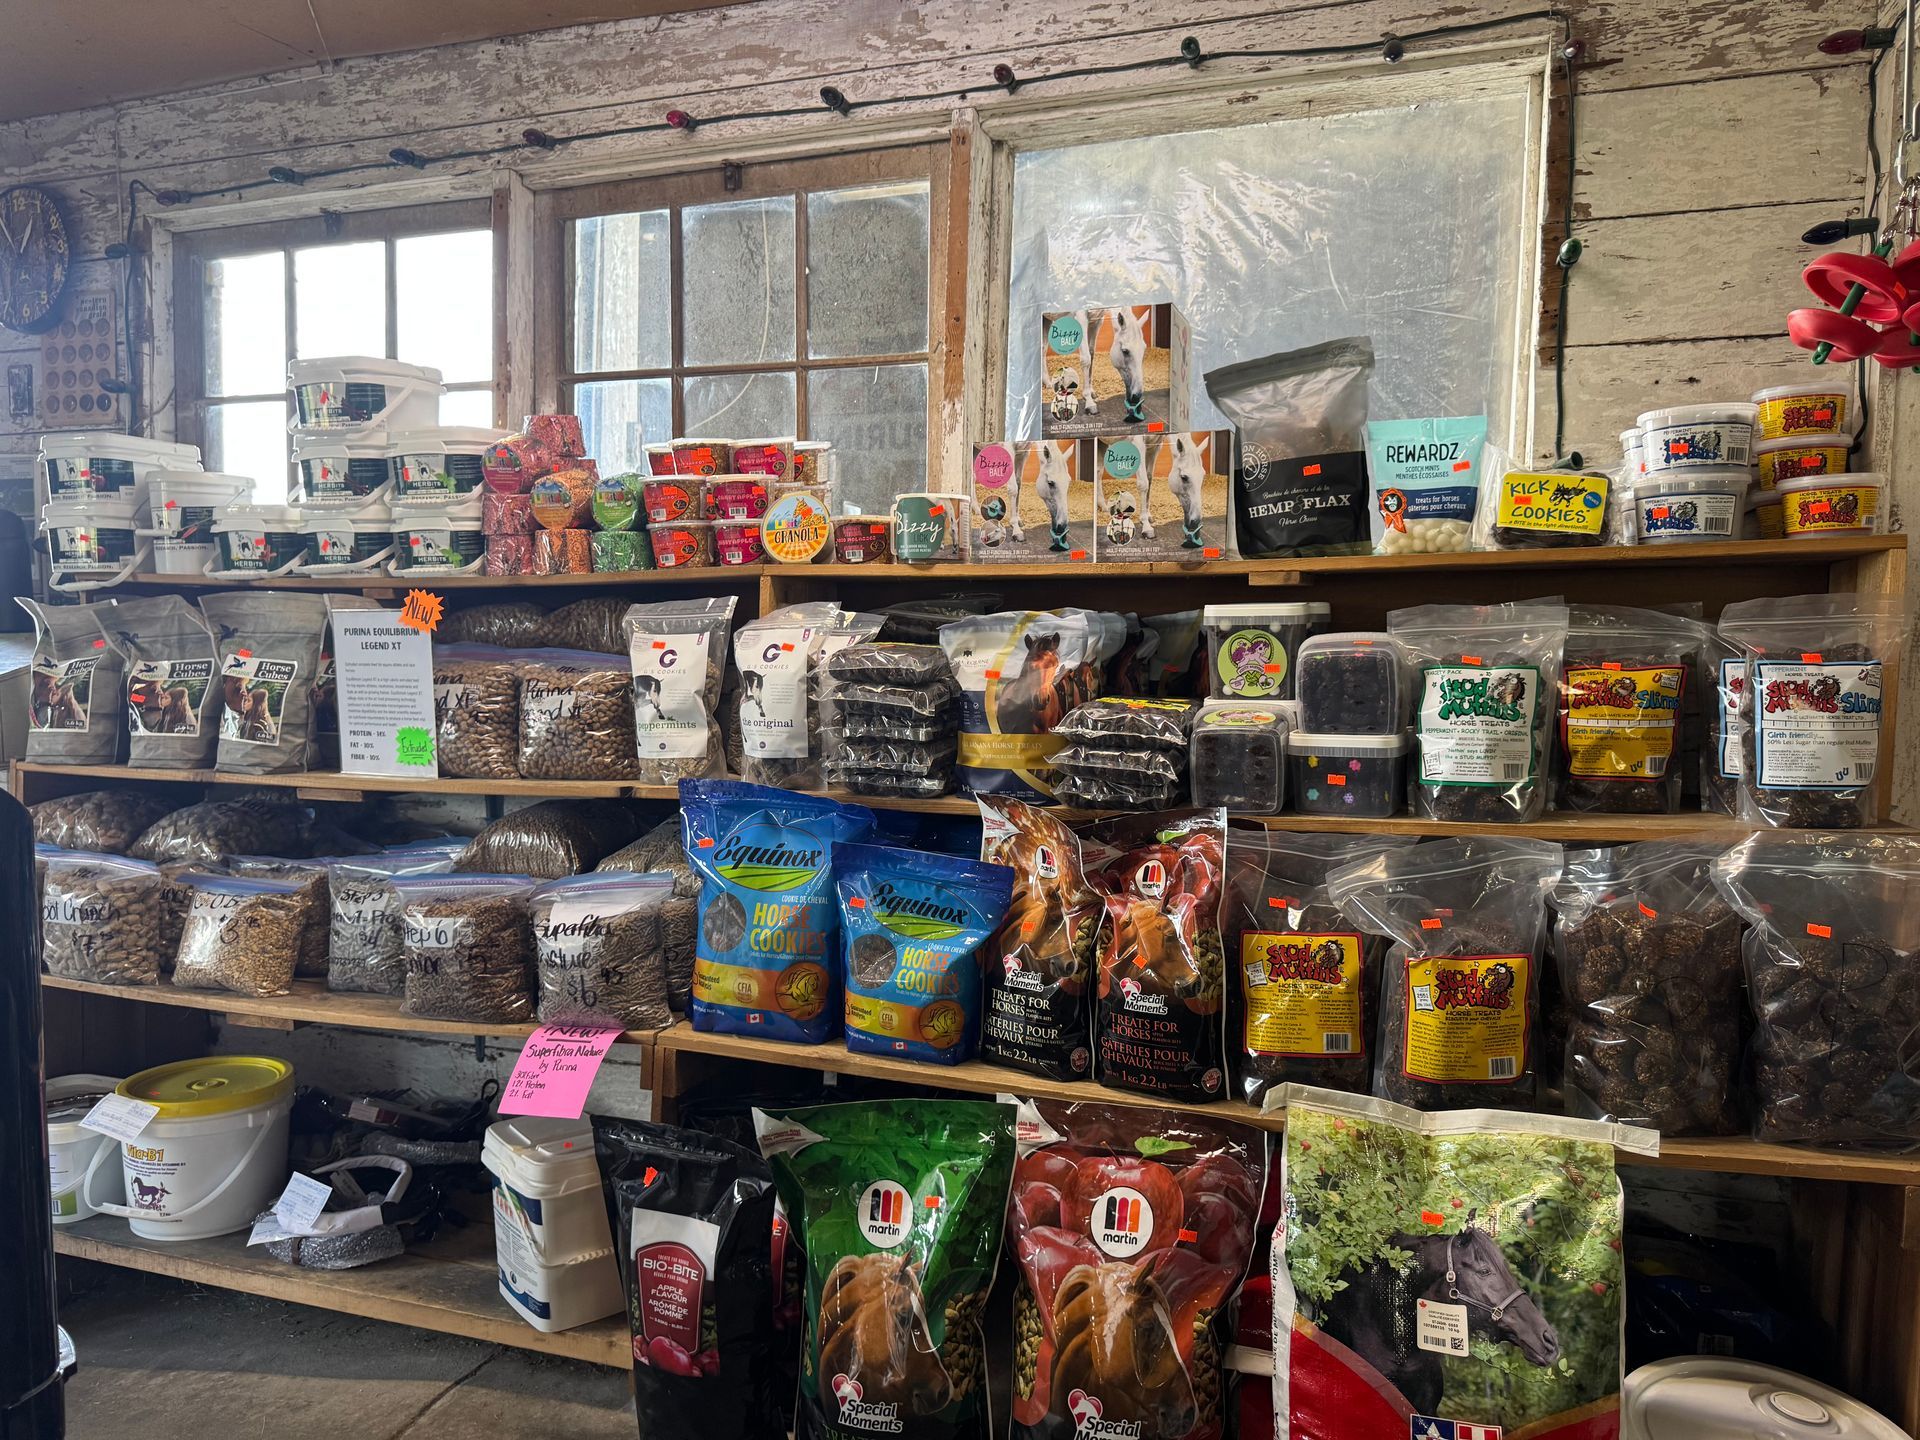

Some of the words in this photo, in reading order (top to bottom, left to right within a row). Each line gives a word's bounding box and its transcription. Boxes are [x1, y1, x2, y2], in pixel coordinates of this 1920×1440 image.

[1052, 326, 1081, 342] Bizzy
[1060, 337, 1076, 347] BALL
[1107, 449, 1139, 467] Bizzy
[1386, 443, 1460, 463] REWARDZ
[980, 455, 1011, 474] Bizzy
[989, 467, 1005, 478] BALL
[1117, 461, 1134, 471] BALL
[1248, 500, 1295, 518] HEMP
[1302, 494, 1352, 510] FLAX
[1432, 495, 1441, 503] for
[774, 526, 819, 544] GRANOLA
[895, 511, 943, 543] Bizzy
[405, 595, 434, 625] NEW
[343, 627, 371, 636] PURINA
[373, 627, 420, 636] EQUILIBRIUM
[360, 641, 390, 651] LEGEND
[391, 641, 402, 651] XT
[173, 669, 208, 679] Cubes
[175, 661, 210, 672] Horse
[260, 661, 292, 673] Horse
[257, 670, 290, 682] Cubes
[638, 720, 698, 733] peppermints
[742, 716, 752, 727] the
[753, 717, 795, 729] original
[1480, 720, 1510, 728] TREATS
[349, 730, 373, 738] PROTEIN
[1767, 731, 1787, 739] Girth
[350, 741, 360, 750] FAT
[992, 741, 1015, 750] HORSE
[350, 753, 366, 762] FIBER
[713, 836, 824, 871] Equinox
[808, 895, 830, 905] CHEVAL
[869, 884, 970, 925] Equinox
[752, 902, 812, 930] HORSE
[435, 919, 449, 946] 6
[750, 929, 828, 954] COOKIES
[901, 946, 951, 974] HORSE
[896, 968, 961, 996] COOKIES
[1011, 968, 1042, 982] Special
[737, 982, 753, 994] CFIA
[1004, 976, 1045, 992] Moments
[991, 987, 1027, 1006] TREATS
[1027, 996, 1051, 1011] FOR
[1130, 992, 1165, 1005] Special
[991, 998, 1026, 1018] HORSES
[1125, 1001, 1169, 1016] Moments
[881, 1012, 894, 1022] CFIA
[1110, 1012, 1151, 1030] TREATS
[1153, 1020, 1180, 1034] FOR
[984, 1023, 1025, 1046] CHEVAUX
[1026, 1024, 1060, 1041] POUR
[1111, 1022, 1152, 1041] HORSES
[526, 1043, 574, 1061] Superfibra
[574, 1045, 605, 1058] Nature
[1101, 1036, 1151, 1058] GÂTERIES
[1153, 1049, 1191, 1063] POUR
[538, 1059, 550, 1074] by
[552, 1059, 578, 1072] Purina
[1101, 1047, 1153, 1071] CHEVAUX
[868, 1223, 901, 1237] martin
[1102, 1232, 1139, 1247] martin
[642, 1258, 700, 1281] BIO-BITE
[650, 1288, 689, 1304] FLAVOUR
[657, 1283, 684, 1297] APPLE
[648, 1298, 677, 1313] ARÔME
[677, 1306, 690, 1316] DE
[653, 1306, 684, 1321] POMME
[847, 1399, 898, 1418] Special
[837, 1409, 903, 1434] Moments
[1085, 1415, 1142, 1439] Special
